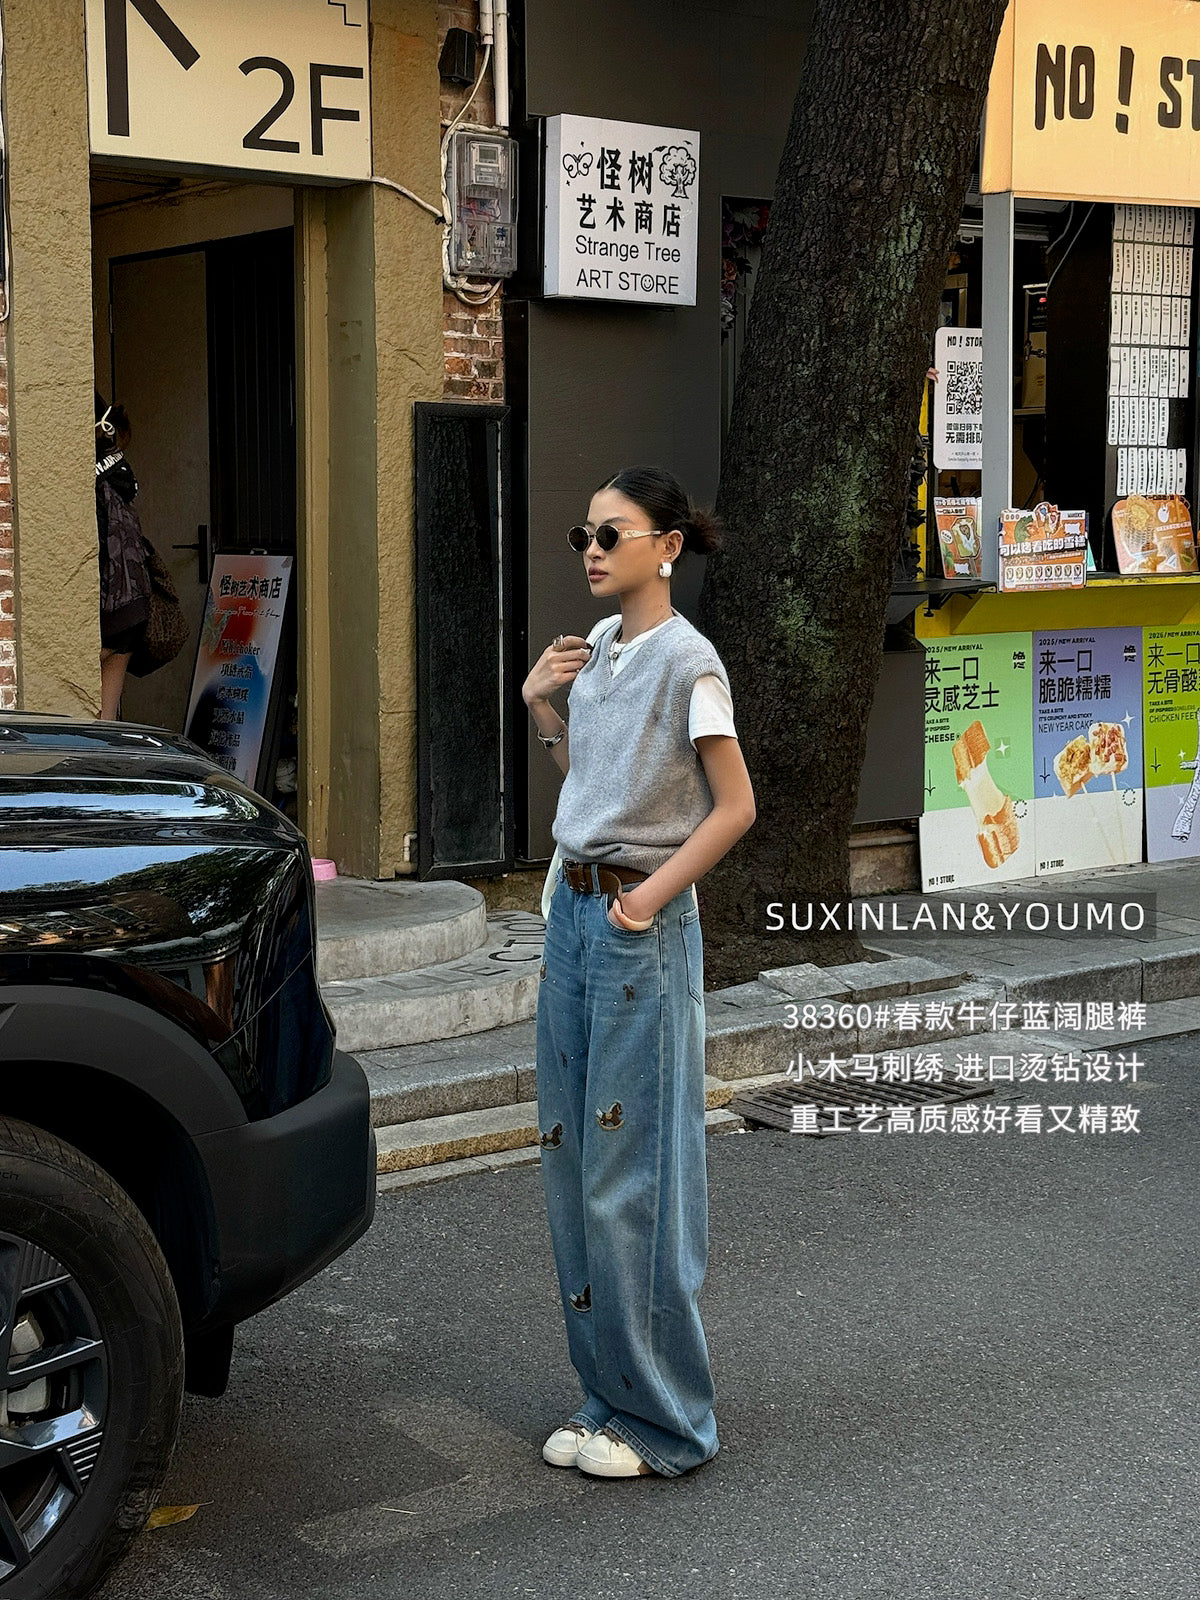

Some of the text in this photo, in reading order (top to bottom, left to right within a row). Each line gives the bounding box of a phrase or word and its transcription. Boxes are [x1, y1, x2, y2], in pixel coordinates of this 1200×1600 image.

[1034, 43, 1096, 131] NO
[238, 56, 364, 156] 2F
[596, 146, 654, 196] 怪树
[576, 193, 682, 238] 艺术商店
[575, 235, 681, 263] Strange Tree
[576, 268, 680, 295] ART STORE
[947, 336, 957, 348] NO
[219, 574, 283, 599] 怪树艺术商店
[1039, 649, 1092, 676] 来一口
[1148, 642, 1200, 668] 来一口
[924, 657, 979, 684] 来一口
[1148, 668, 1200, 694] 无骨酸
[924, 682, 1000, 714] 灵感芝士
[1039, 674, 1112, 704] 脆脆糯糯
[1038, 724, 1055, 734] NEW
[1056, 722, 1074, 732] YEAR
[1149, 711, 1198, 724] CHICKEN FEET
